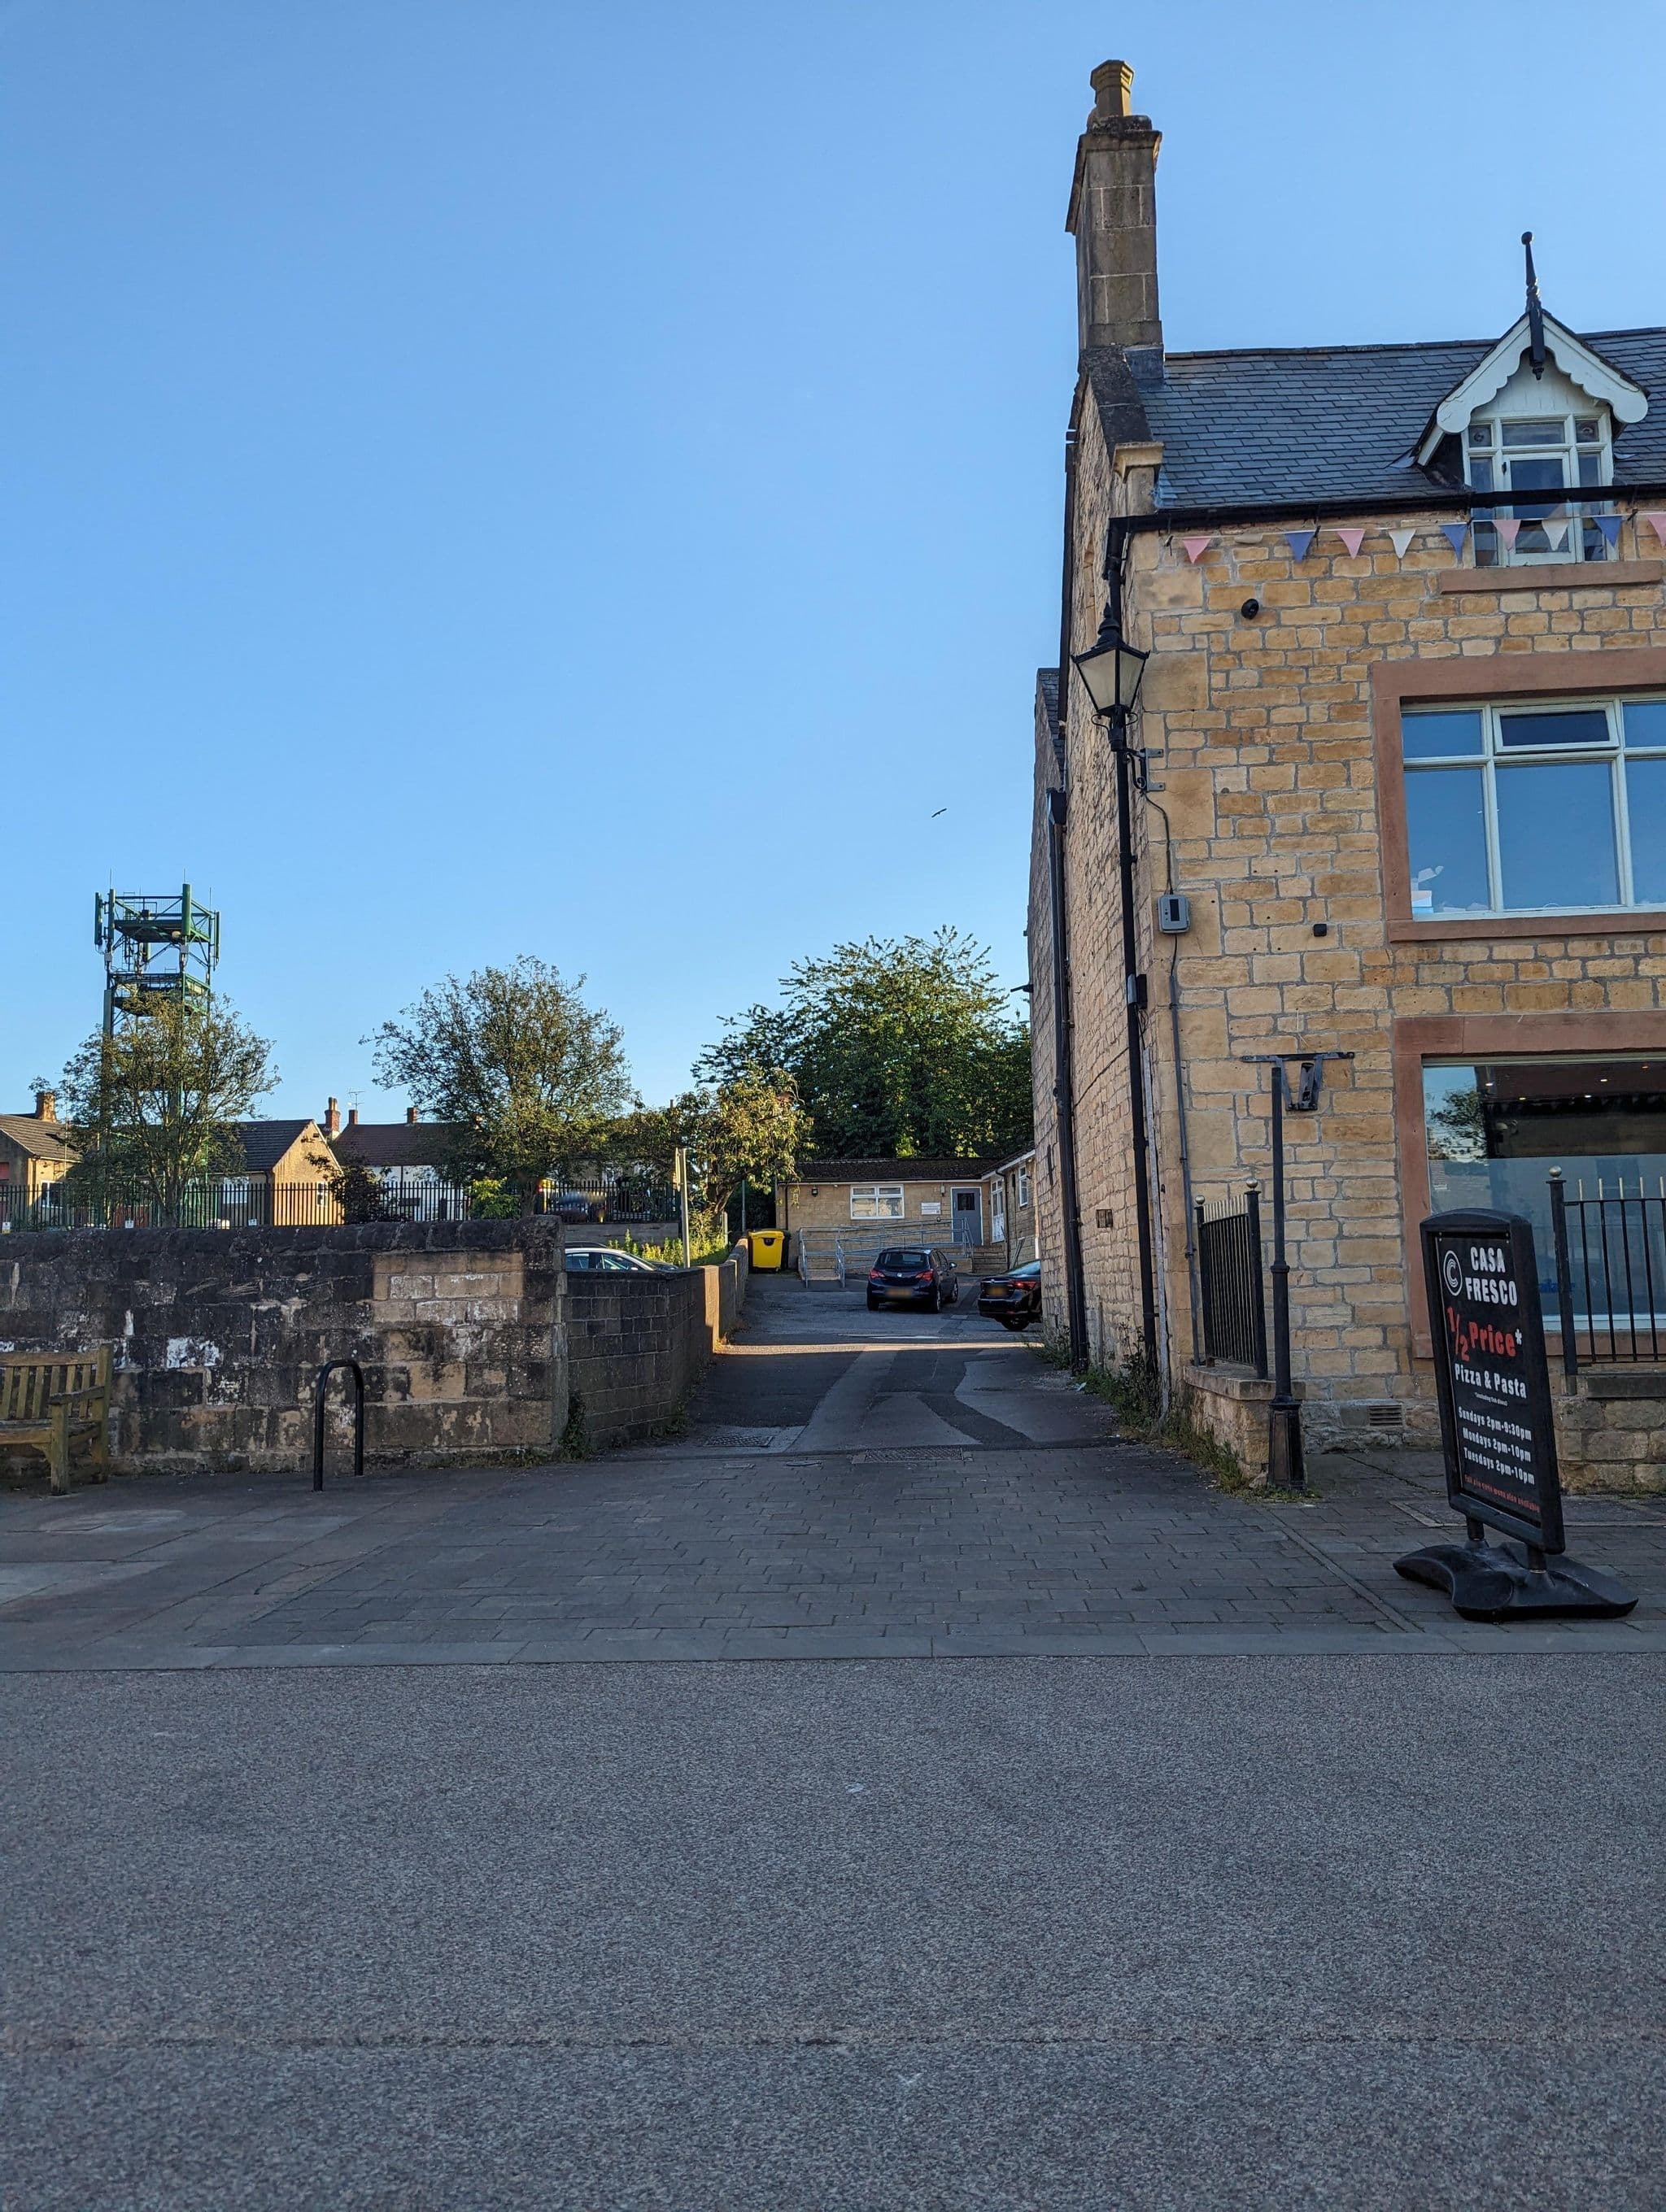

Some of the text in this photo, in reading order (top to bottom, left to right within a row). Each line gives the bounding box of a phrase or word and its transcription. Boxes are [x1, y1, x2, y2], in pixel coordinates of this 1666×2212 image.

[1470, 1246, 1507, 1274] CASA
[1465, 1277, 1518, 1306] FRESCO
[1454, 1363, 1527, 1399] Pizza & Pasta
[1458, 1406, 1532, 1441] Sundays 2pm-9:30pm
[1463, 1426, 1531, 1463] Mondays 2pm-10pm
[1463, 1447, 1535, 1485] Tuesdays 2pm-10pm
